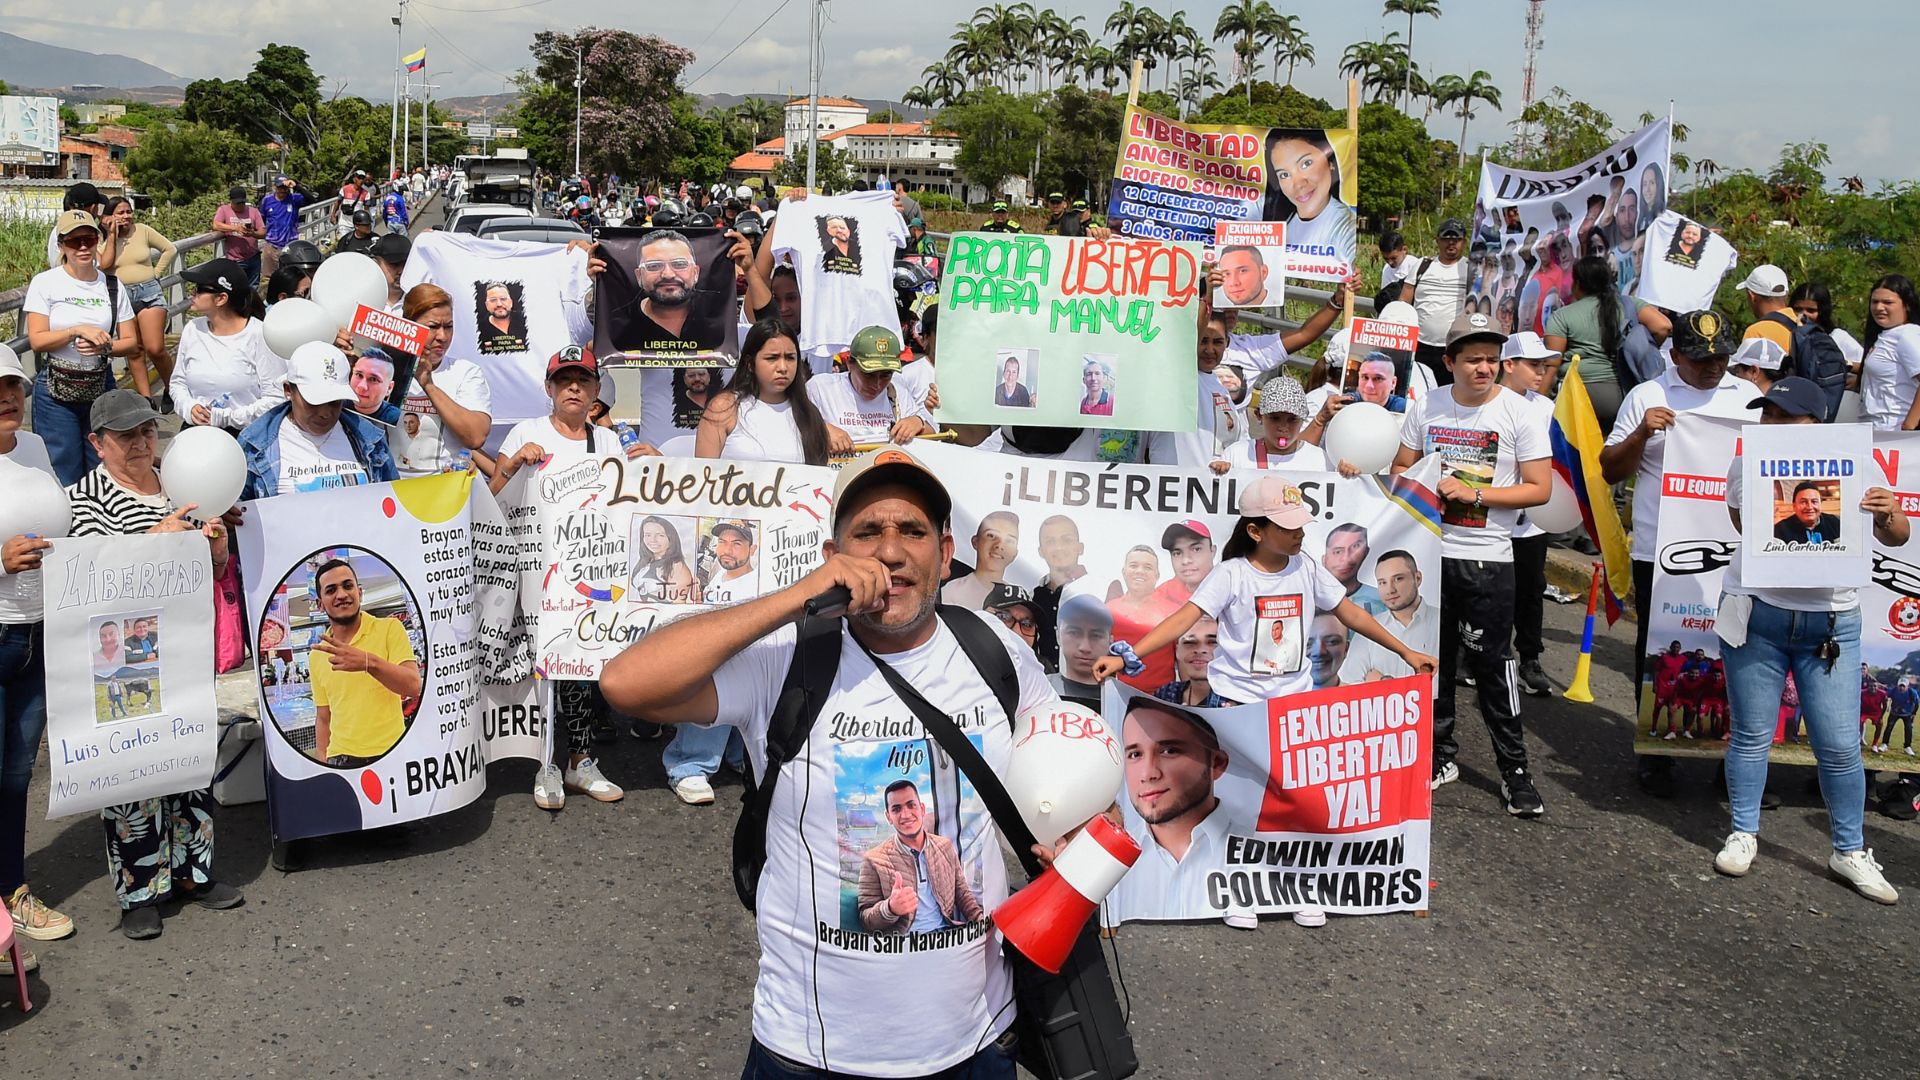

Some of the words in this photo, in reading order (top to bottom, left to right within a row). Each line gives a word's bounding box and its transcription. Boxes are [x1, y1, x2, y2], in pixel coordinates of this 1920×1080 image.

[1128, 112, 1259, 159] LIBERTAD
[1124, 142, 1189, 170] ANGIE
[1192, 158, 1263, 183] PAOLA
[1121, 165, 1188, 191] RIOFRIO
[1191, 177, 1260, 201] SOLANO
[1120, 201, 1146, 217] FUE
[1146, 206, 1209, 229] RETENIDA
[1123, 186, 1138, 199] 12
[1140, 188, 1157, 204] DE
[1158, 192, 1215, 214] FEBRERO
[1215, 203, 1248, 218] 2022
[1121, 219, 1132, 233] 3
[1132, 220, 1172, 240] AÑOS
[1173, 229, 1184, 240] 8
[1219, 234, 1262, 245] LIBERTAD
[1263, 235, 1279, 245] YA!
[1226, 223, 1273, 236] ¡EXIGIMOS
[1285, 243, 1335, 257] EZUELA
[1061, 238, 1198, 300] LIBERTAD
[949, 275, 1039, 315] PARA
[1049, 296, 1161, 343] MANUEL
[365, 310, 418, 338] ¡EXIGIMOS
[1362, 320, 1409, 337] ¡EXIGIMOS
[355, 321, 402, 347] LIBERTAD
[403, 336, 420, 354] YA!
[644, 340, 698, 350] LIBERTAD
[1354, 332, 1397, 348] LIBERTAD
[1398, 338, 1414, 351] YA!
[624, 359, 669, 367] WILSON
[671, 359, 718, 367] VARGAS
[655, 350, 685, 359] PARA
[1441, 451, 1485, 460] AVARRO
[1760, 459, 1854, 477] LIBERTAD
[288, 464, 332, 478] Libertad
[335, 462, 358, 475] para
[600, 457, 786, 509] Libertad
[321, 478, 341, 489] hijo
[541, 464, 598, 504] Queremos
[1001, 462, 1336, 520] ¡LIBÉRENLS!
[1668, 476, 1686, 493] TU
[1687, 478, 1727, 497] EQUIP
[421, 527, 467, 549] Brayan,
[470, 520, 502, 536] onrisa
[424, 547, 455, 564] estás
[458, 545, 470, 559] en
[566, 538, 625, 561] Zuleima
[1762, 541, 1785, 552] Luis
[1788, 541, 1819, 552] Carlos
[772, 550, 817, 572] Johan
[428, 591, 435, 608] y
[438, 583, 449, 600] tú
[453, 578, 474, 598] sobr
[656, 578, 732, 602] Justicia
[430, 606, 453, 624] muy
[456, 598, 475, 616] fuer
[1662, 602, 1717, 617] PubliSer
[433, 643, 456, 659] Esta
[437, 680, 464, 696] amor
[466, 677, 472, 694] y
[438, 702, 457, 715] voz
[459, 695, 475, 716] que
[440, 719, 458, 740] por
[461, 713, 470, 728] ti.
[482, 704, 547, 741] UERE
[828, 711, 917, 741] Libertad
[975, 704, 987, 727] ti
[1278, 690, 1420, 752] ¡EXIGIMOS
[61, 738, 99, 766] Luis
[109, 726, 160, 755] Carlos
[171, 717, 205, 741] Peña
[887, 743, 927, 775] hijo
[1281, 729, 1418, 790] LIBERTAD
[89, 772, 120, 792] MAS
[129, 755, 201, 783] INJUSTICIA
[1323, 775, 1381, 829] YA!
[1226, 834, 1334, 868] EDWIN
[1337, 832, 1405, 867] IVAN
[1206, 868, 1422, 910] COLMENARES
[819, 920, 869, 952] Brayan
[873, 931, 906, 954] Sair
[909, 926, 964, 953] Navarro
